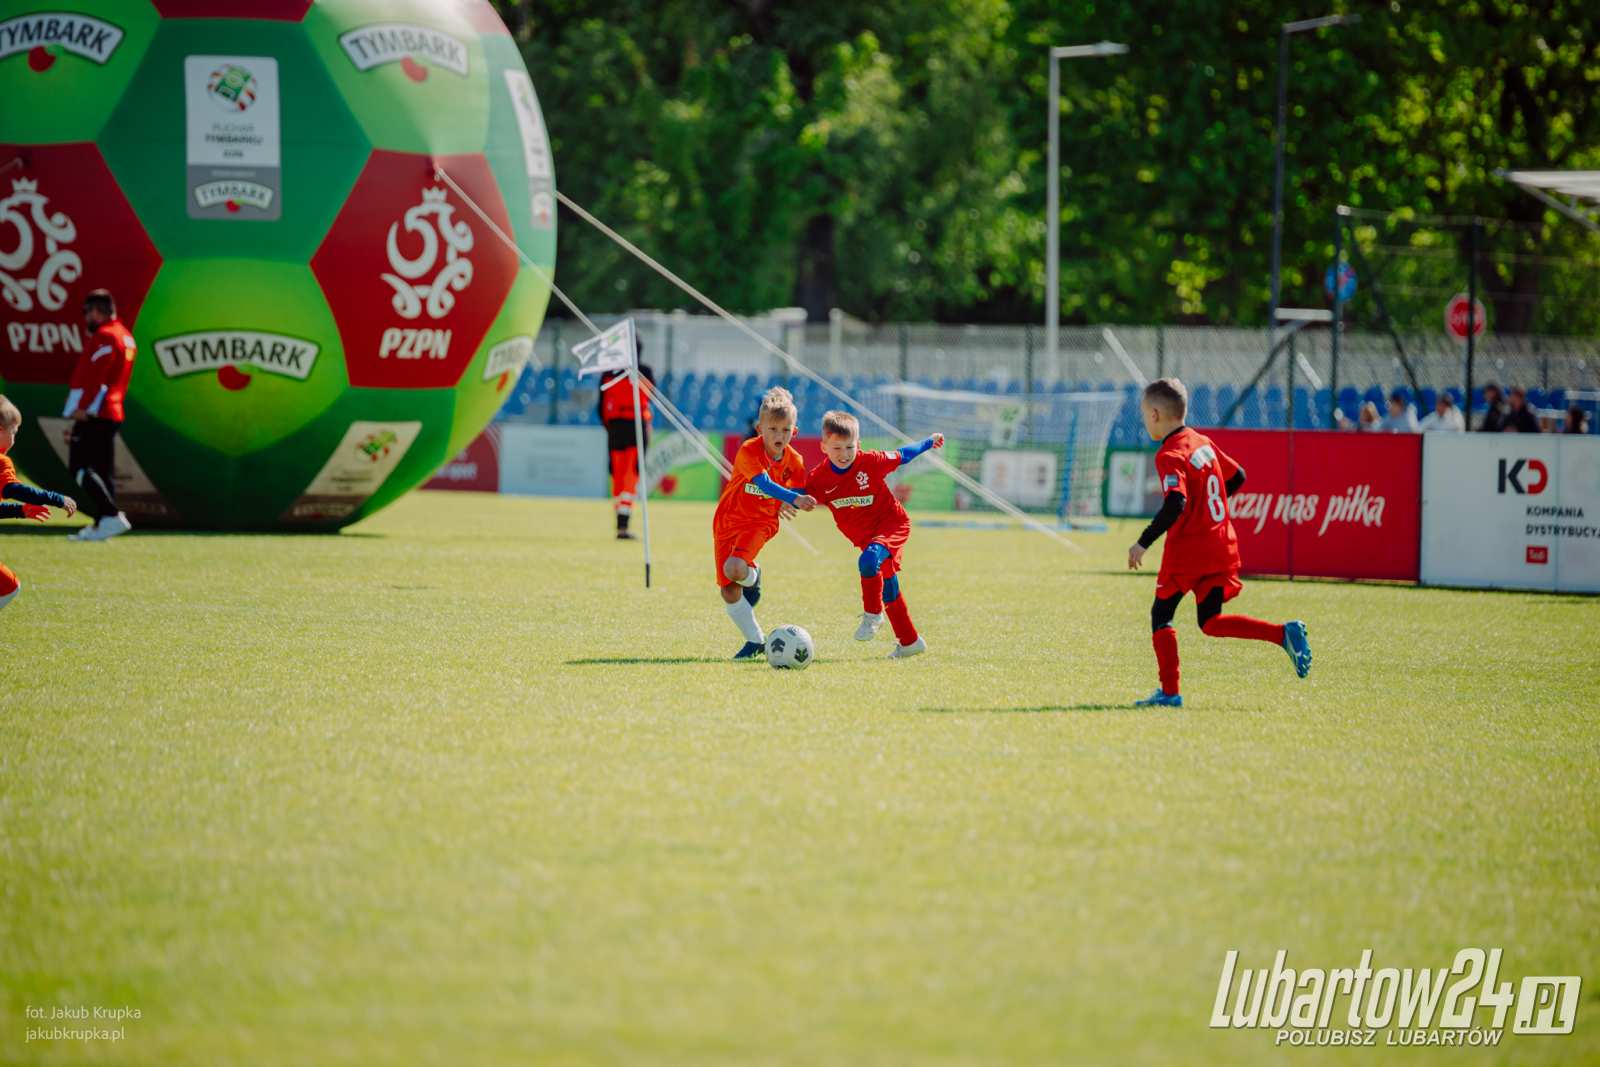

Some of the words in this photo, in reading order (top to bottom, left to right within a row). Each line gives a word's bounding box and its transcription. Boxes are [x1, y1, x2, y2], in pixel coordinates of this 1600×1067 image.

[348, 30, 463, 65] TYMBARK
[7, 321, 83, 352] PZPN
[379, 327, 453, 359] PZPN
[164, 337, 306, 369] TYMBARK
[1207, 474, 1225, 522] 8
[1227, 492, 1273, 534] czy
[1273, 493, 1319, 524] nas
[1318, 485, 1385, 536] piłka
[1526, 505, 1584, 518] KOMPANIA
